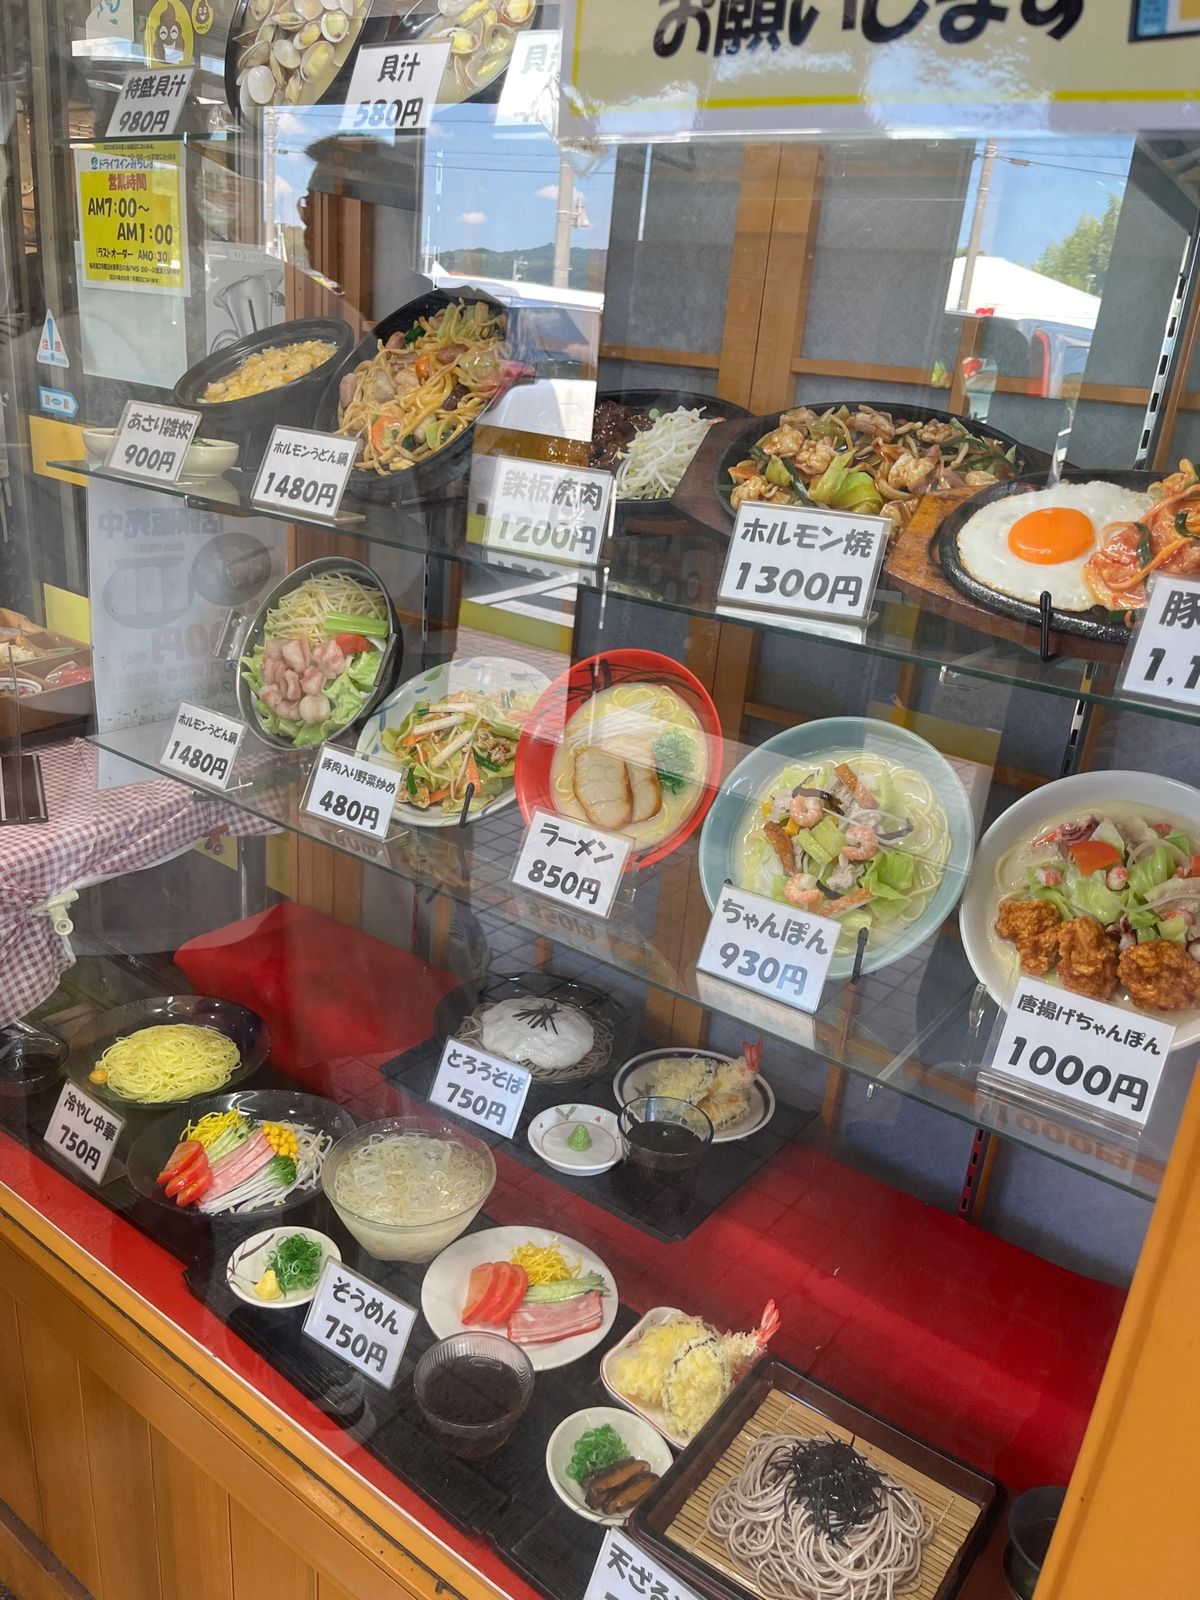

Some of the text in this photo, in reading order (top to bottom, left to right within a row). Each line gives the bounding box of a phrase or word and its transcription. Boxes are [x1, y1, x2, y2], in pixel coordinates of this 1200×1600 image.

[124, 74, 186, 99] 特盛貝汁
[377, 52, 421, 82] 貝汁
[119, 110, 170, 133] 980円
[353, 97, 423, 127] 580円
[108, 173, 147, 191] 営業時間
[117, 222, 173, 245] AM1:00
[127, 412, 193, 440] あさり雑炊
[124, 444, 176, 473] 900円
[273, 441, 349, 467] ホルモンうどん鍋
[263, 472, 338, 508] 1480円
[502, 470, 603, 511] 鉄板焼肉
[498, 513, 597, 556] 1200円
[741, 517, 875, 559] ホルモン焼
[735, 562, 863, 607] 1300円
[177, 713, 238, 746] ホルモンうどん鍋
[168, 740, 230, 780] 1480円
[321, 757, 396, 794] 豚肉入り野菜炒め
[319, 790, 380, 830] 480円
[540, 822, 614, 864] ラーメン
[527, 859, 602, 905] 850円
[722, 898, 828, 955] ちゃんぽん
[719, 942, 808, 996] 930円
[1017, 993, 1161, 1056] 唐揚げちゃんぽん
[446, 1050, 525, 1095] とろろそば
[1008, 1036, 1149, 1112] 1000円
[63, 1091, 117, 1142] 冷やし中華
[446, 1083, 507, 1126] 750円
[59, 1125, 101, 1171] 750円
[331, 1277, 399, 1336] そうめん
[325, 1315, 388, 1372] 750円
[607, 1542, 681, 1600] 天ざる
